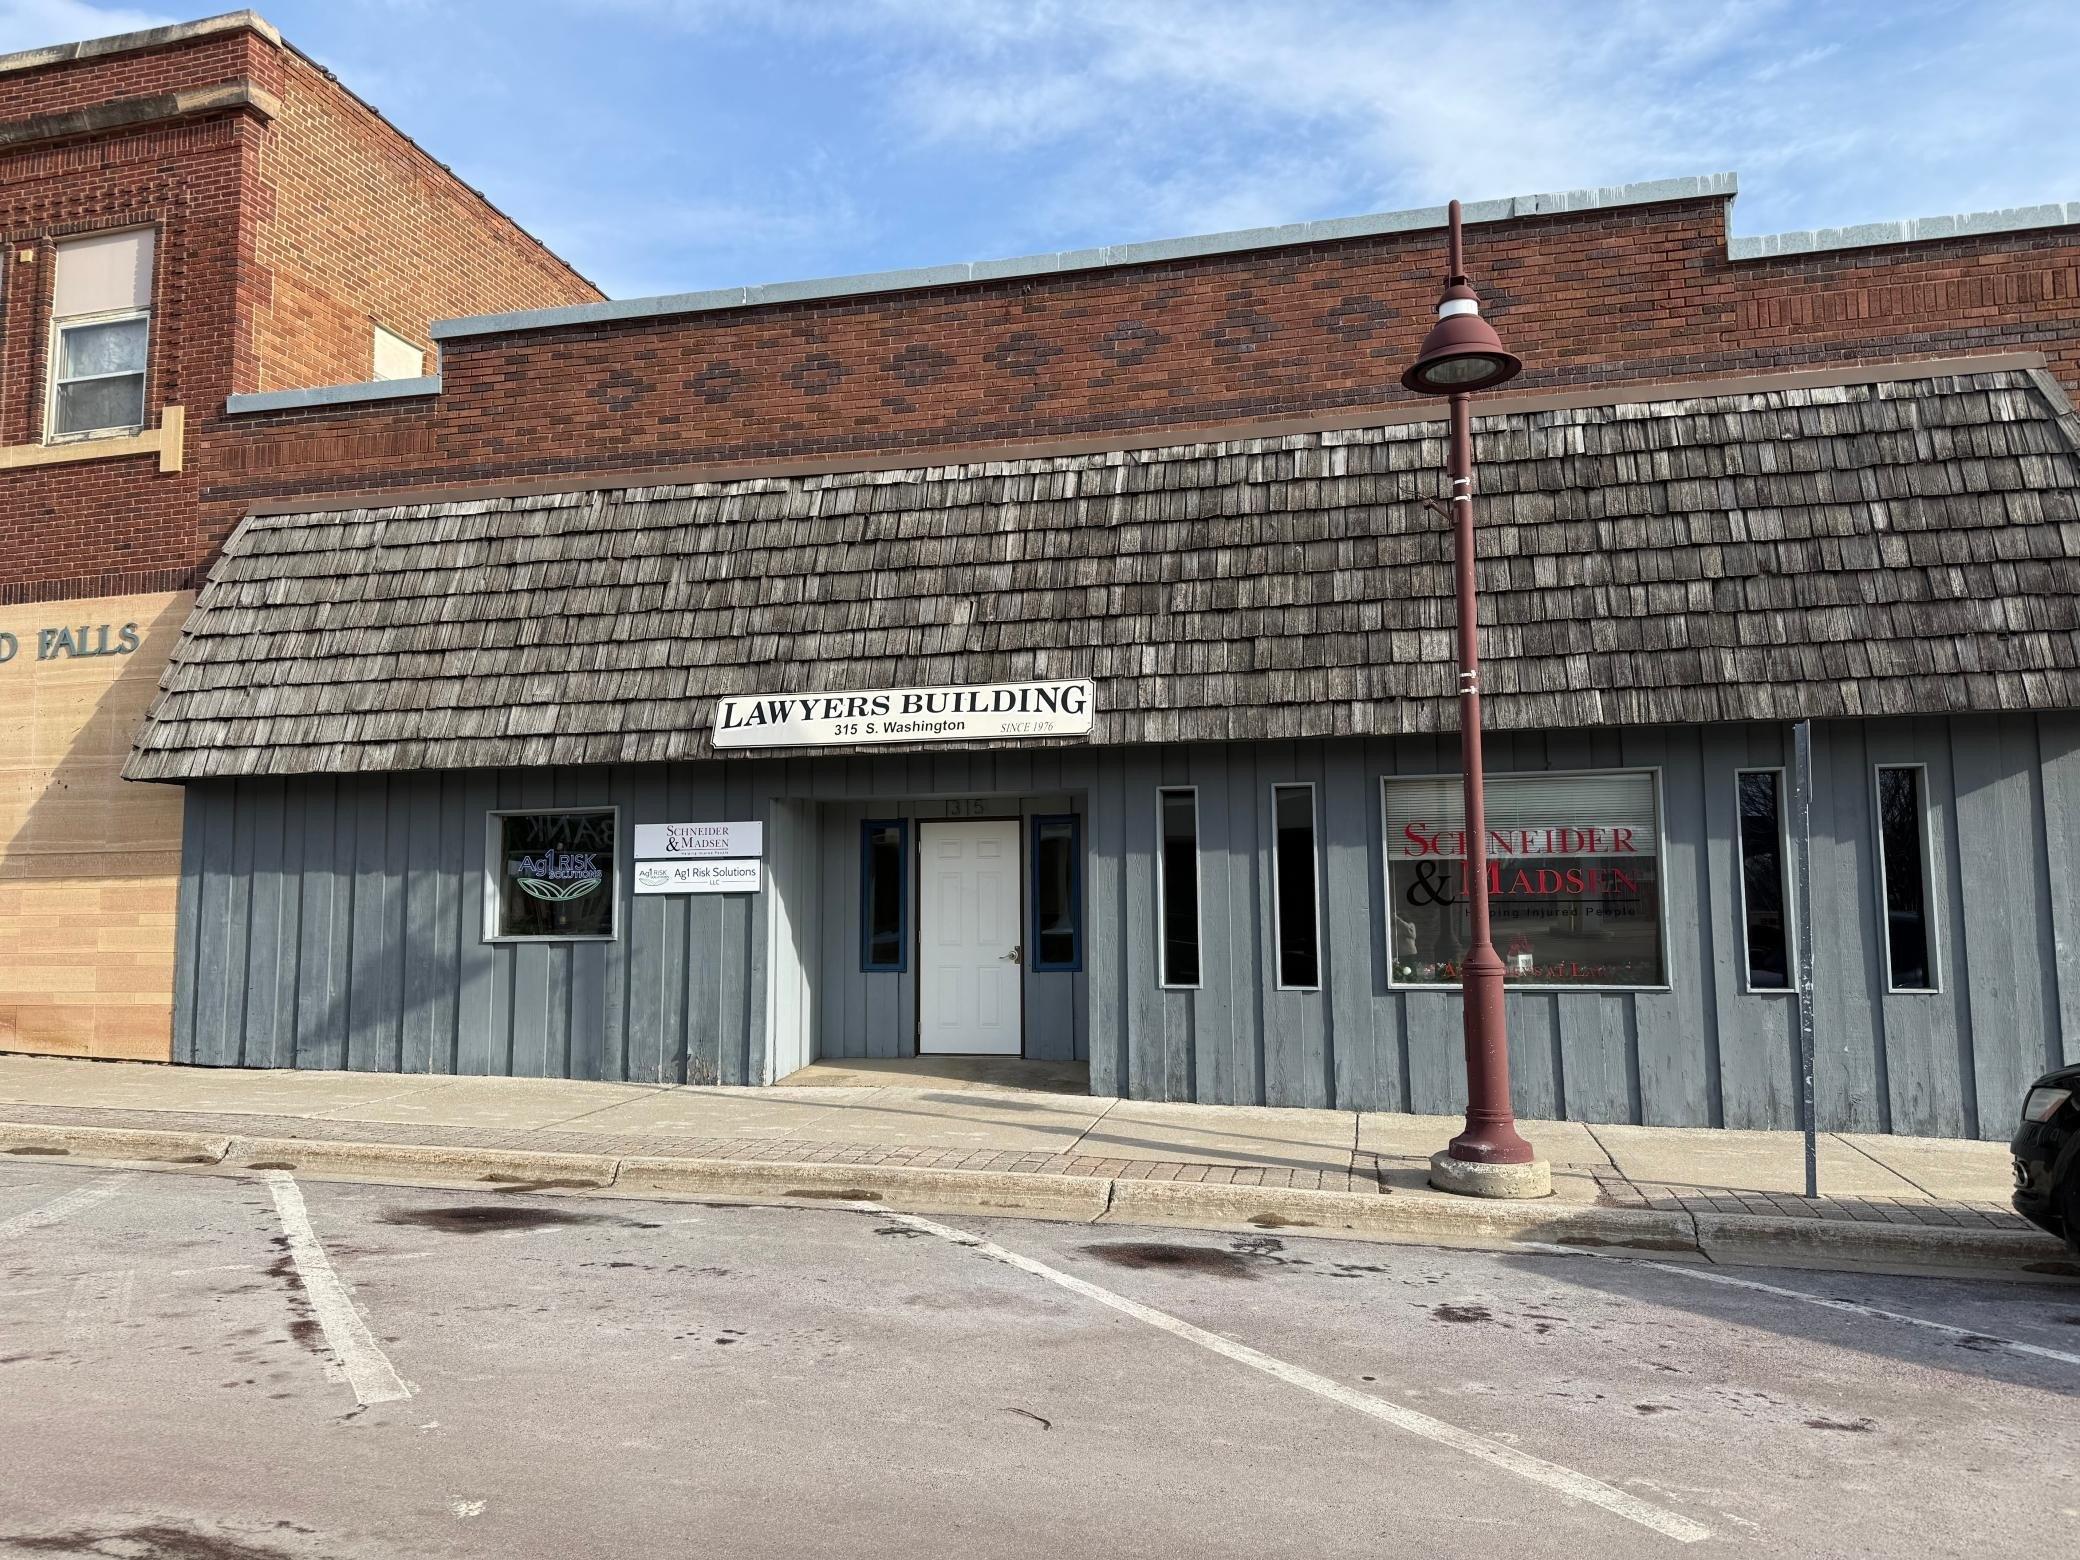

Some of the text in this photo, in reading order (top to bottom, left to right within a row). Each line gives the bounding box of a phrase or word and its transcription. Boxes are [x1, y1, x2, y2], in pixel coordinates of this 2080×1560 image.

[35, 622, 140, 661] FALLS
[720, 685, 1086, 730] LAWYERS BUILDING
[834, 720, 965, 736] 315 S. Washington
[1000, 721, 1054, 733] SINCE 1976
[667, 824, 729, 837] SCHNEIDER
[666, 836, 729, 852] & MADSEN
[518, 849, 597, 877] Ag1 RISK
[548, 869, 602, 880] SOLUTIONS
[674, 868, 690, 881] Ag1
[693, 867, 711, 877] Risk
[713, 866, 756, 877] Solutions
[1406, 860, 1455, 907] &
[1527, 906, 1578, 919] Injured
[1586, 907, 1636, 918] People
